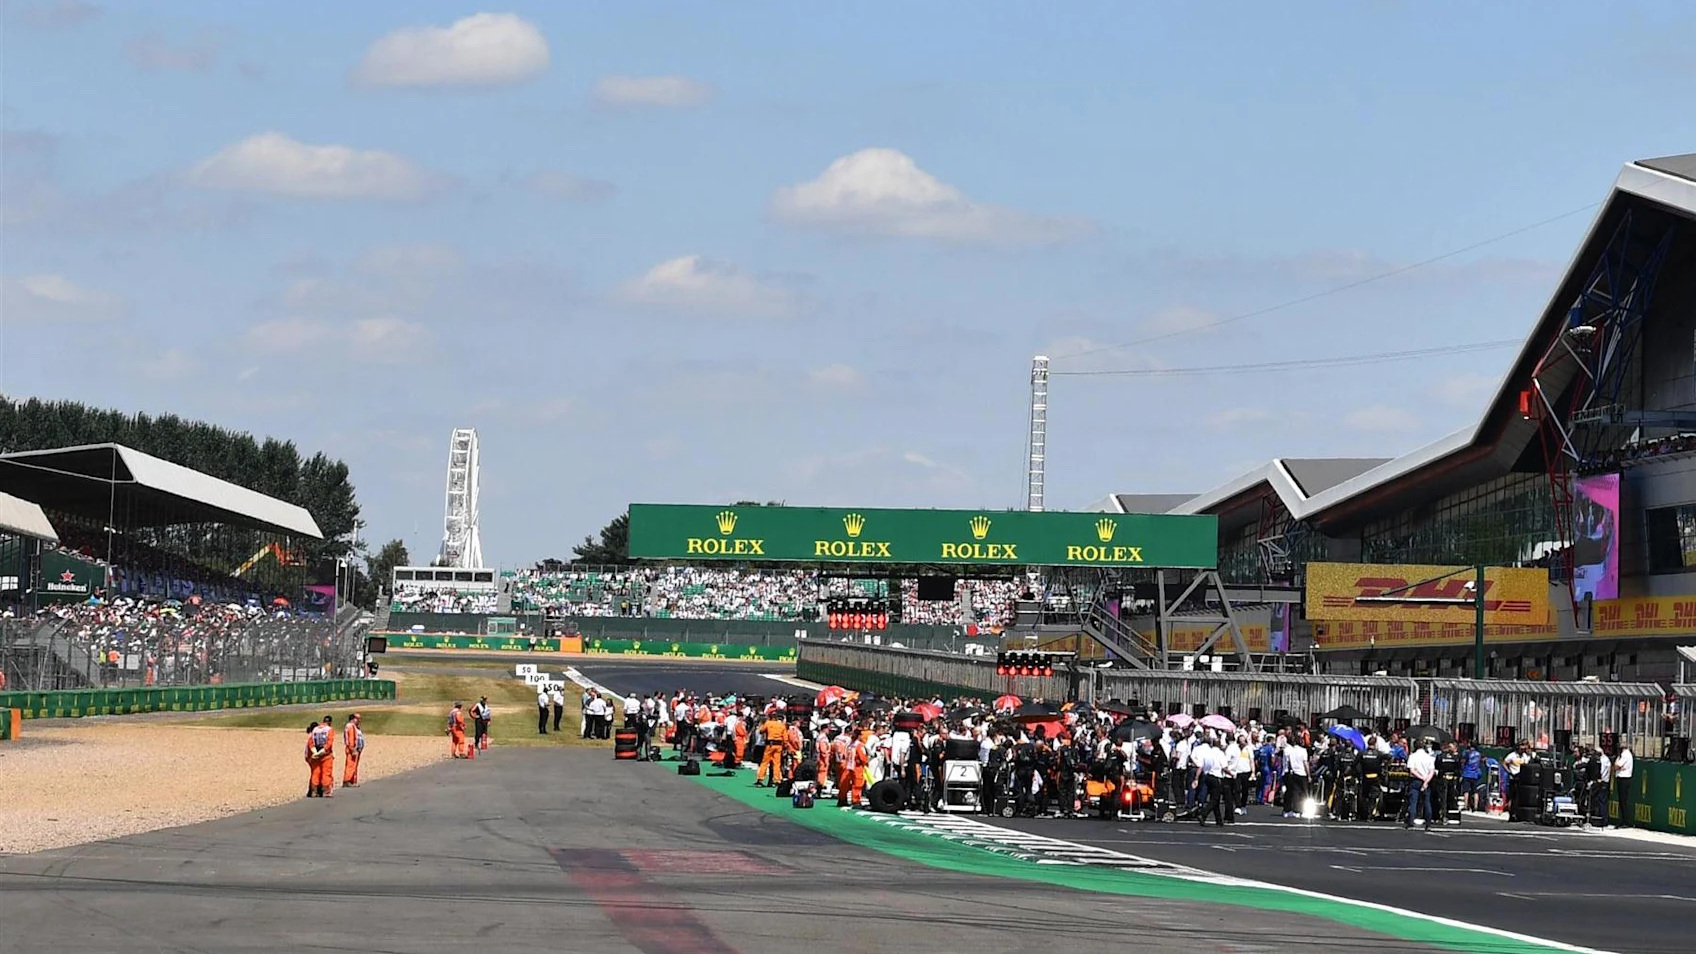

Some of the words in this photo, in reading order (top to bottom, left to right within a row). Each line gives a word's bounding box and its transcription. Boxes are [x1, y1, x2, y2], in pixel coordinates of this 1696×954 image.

[686, 538, 764, 555] ROLEX
[814, 540, 892, 557] ROLEX
[941, 543, 1018, 559] ROLEX
[1067, 546, 1143, 562] ROLEX
[47, 582, 87, 592] Heineken
[1599, 605, 1623, 630] DHL
[1634, 603, 1661, 628] DHL
[530, 675, 545, 683] 100
[960, 766, 967, 777] 2
[1668, 807, 1687, 828] ROLEX
